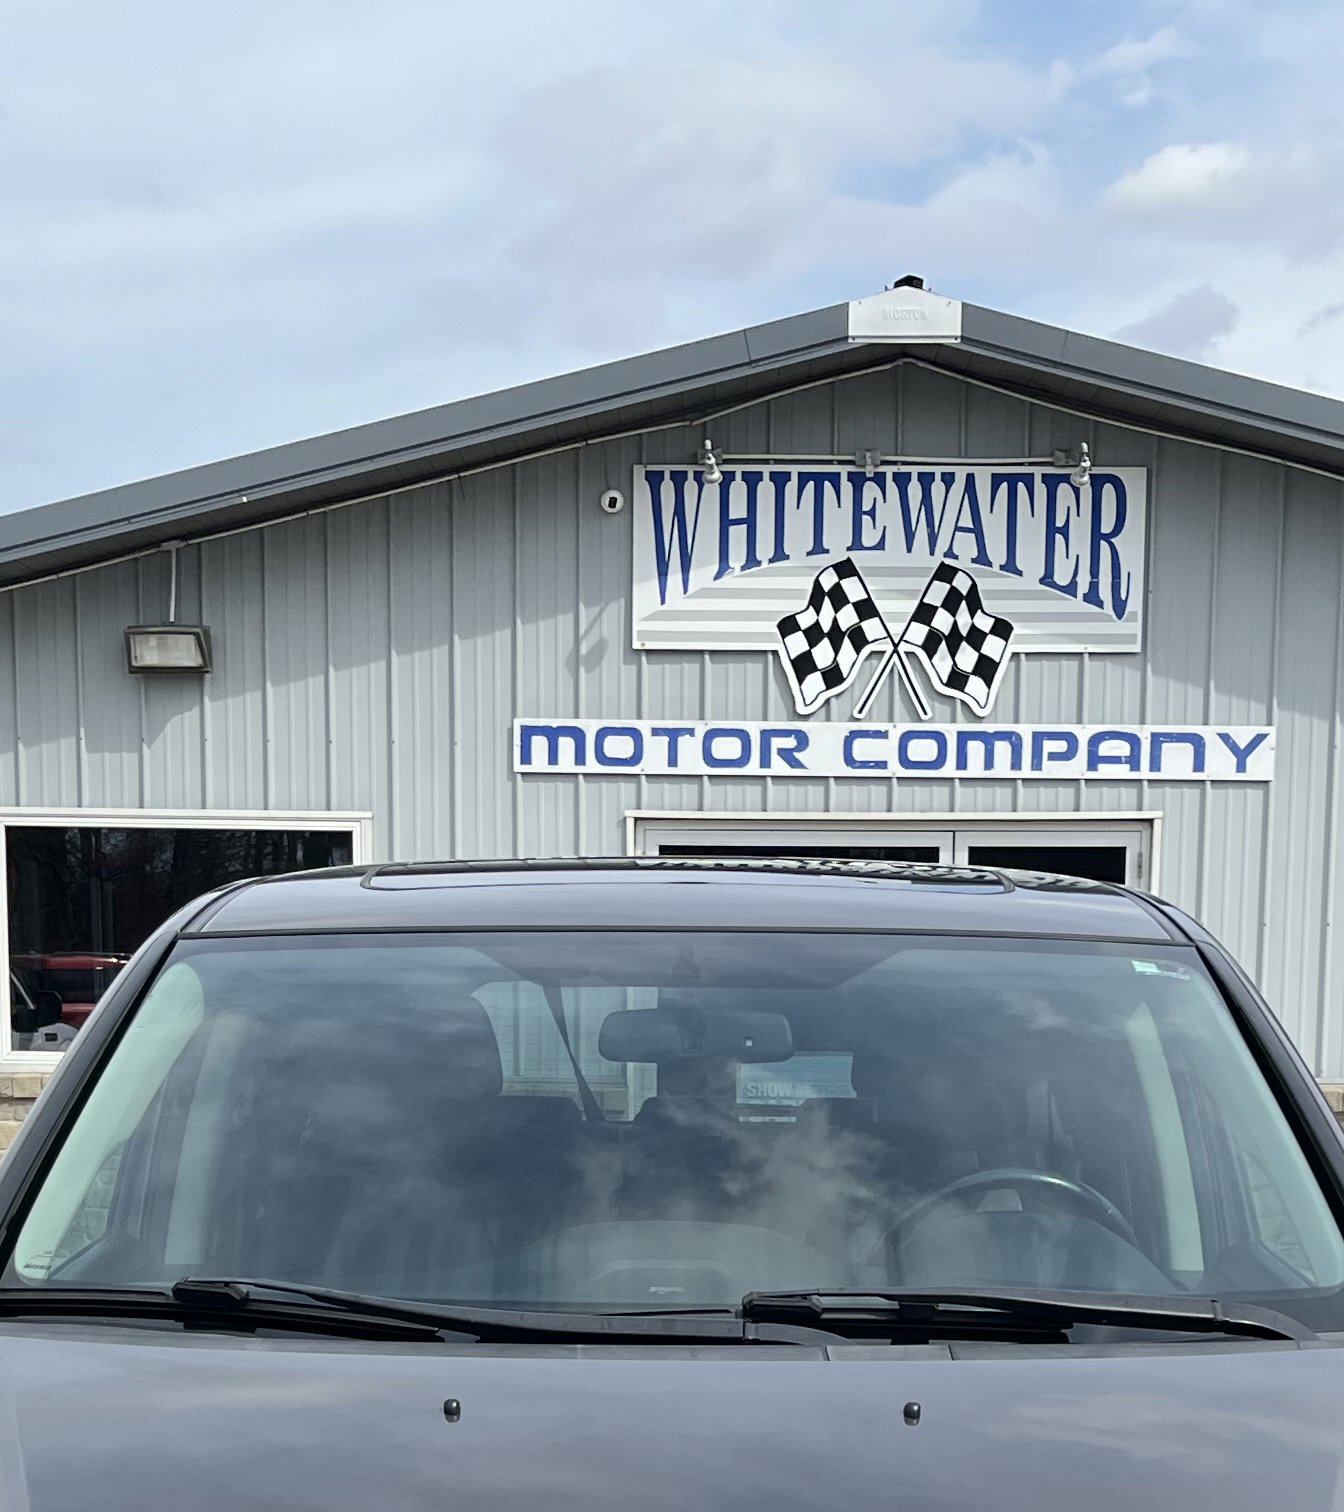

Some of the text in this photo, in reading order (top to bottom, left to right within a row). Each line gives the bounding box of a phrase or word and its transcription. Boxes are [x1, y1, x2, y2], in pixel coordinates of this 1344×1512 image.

[644, 468, 1132, 622] WHITEWATER
[519, 724, 1270, 774] MOTOR COMPANY
[746, 1081, 793, 1097] SHOW
